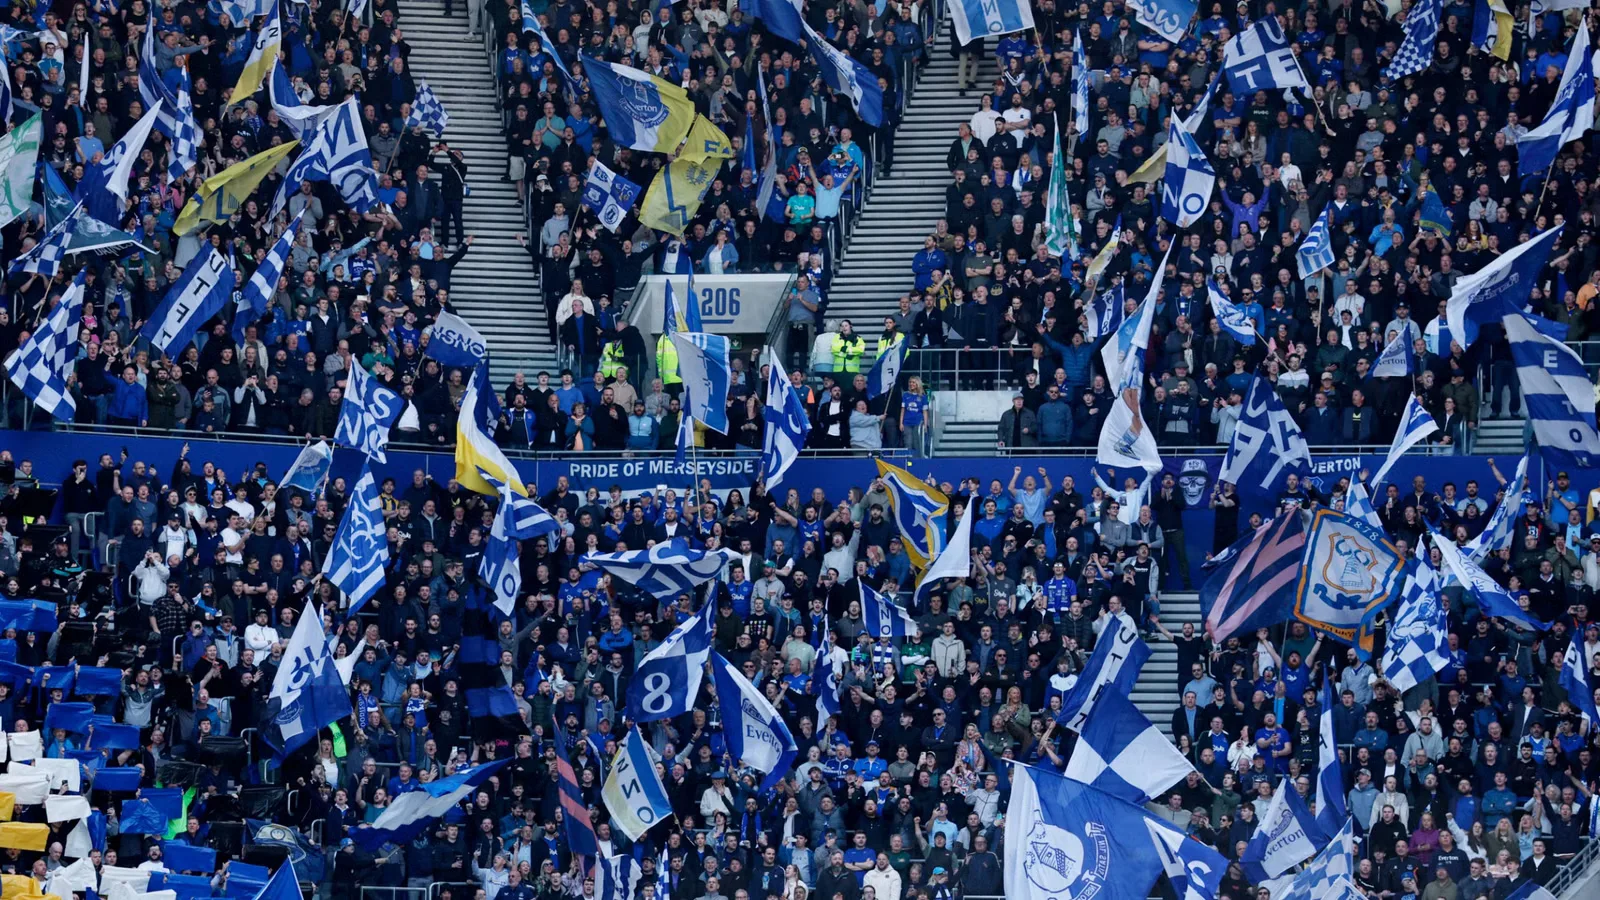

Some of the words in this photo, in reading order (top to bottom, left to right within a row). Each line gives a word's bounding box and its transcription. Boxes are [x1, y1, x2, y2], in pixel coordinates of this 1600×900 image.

[701, 287, 741, 317] 206
[569, 463, 619, 478] PRIDE
[623, 461, 645, 477] OF
[649, 459, 755, 476] MERSEYSIDE
[1343, 516, 1378, 542] 1878
